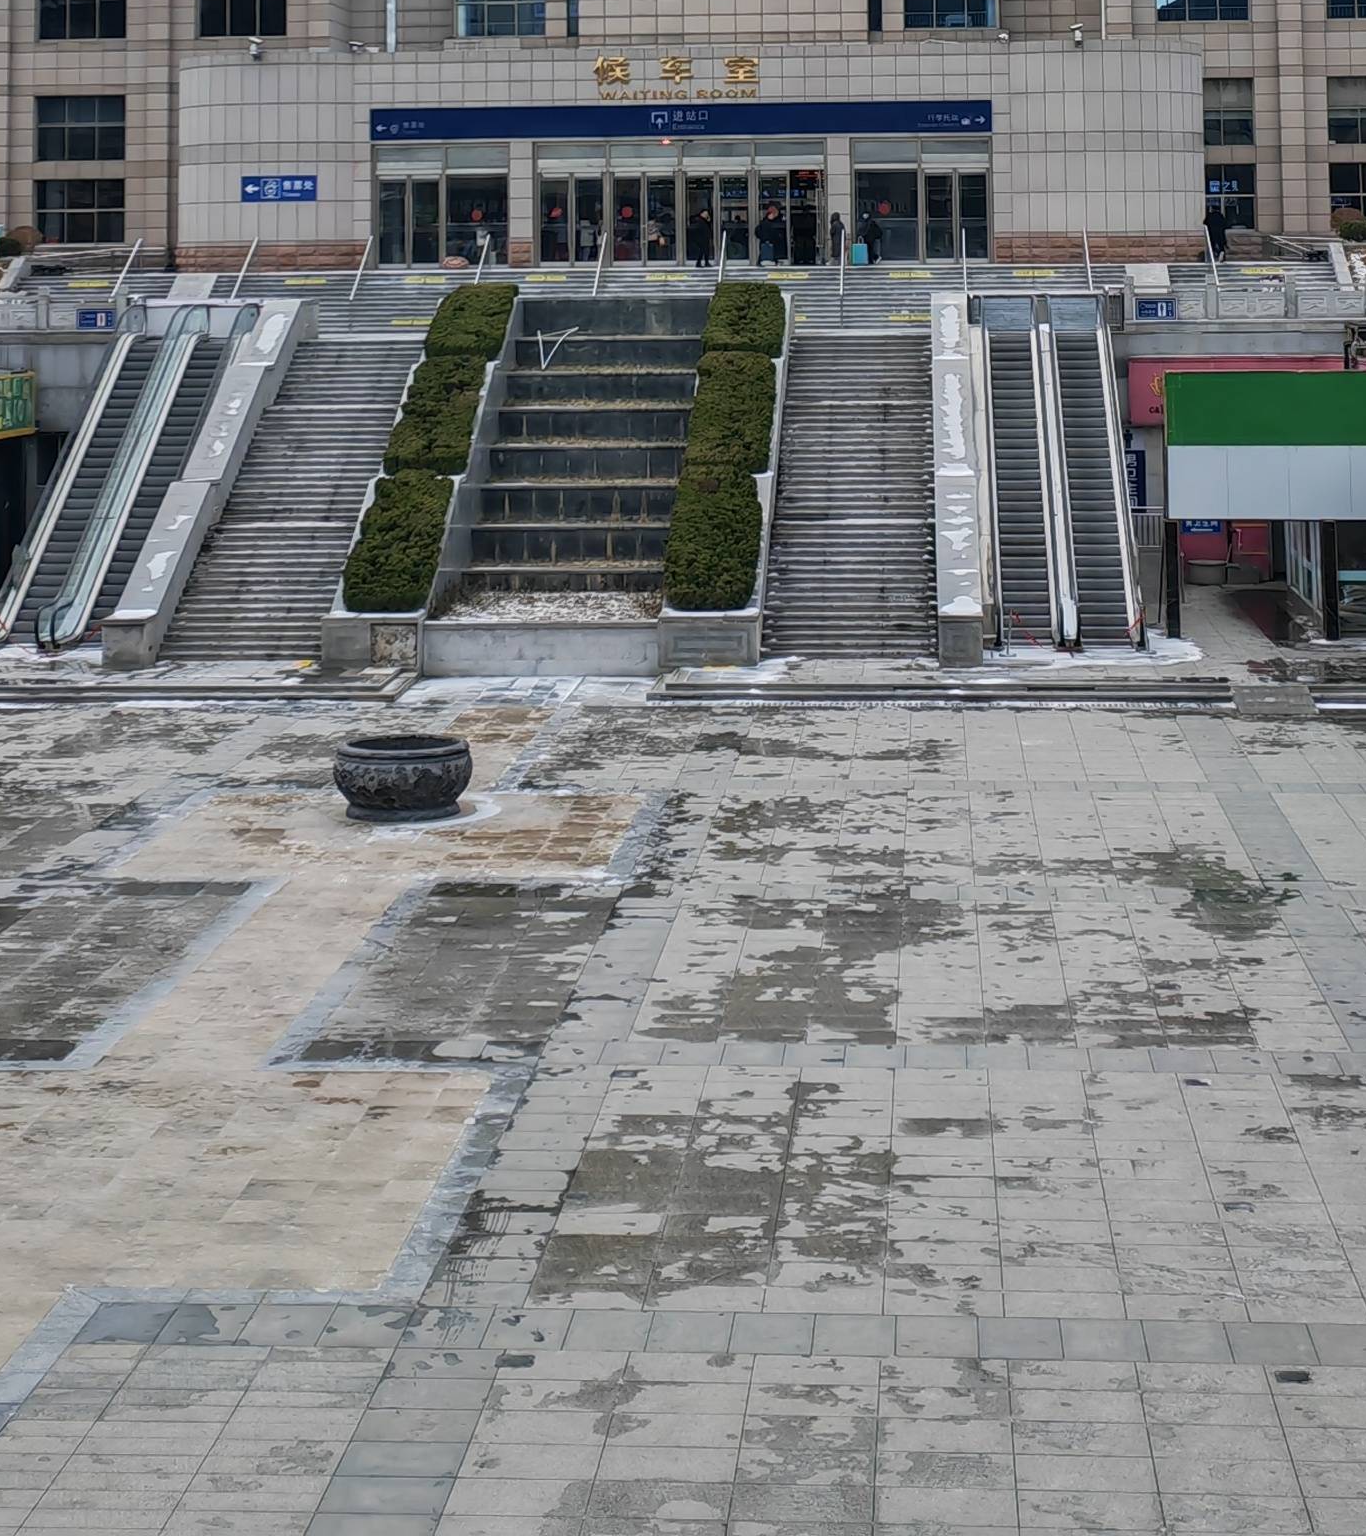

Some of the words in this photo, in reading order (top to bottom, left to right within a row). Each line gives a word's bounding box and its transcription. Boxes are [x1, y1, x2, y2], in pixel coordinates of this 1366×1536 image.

[593, 55, 761, 86] 候车室
[601, 89, 689, 101] WAITING
[696, 88, 757, 99] ROOM
[672, 110, 708, 122] 进站口
